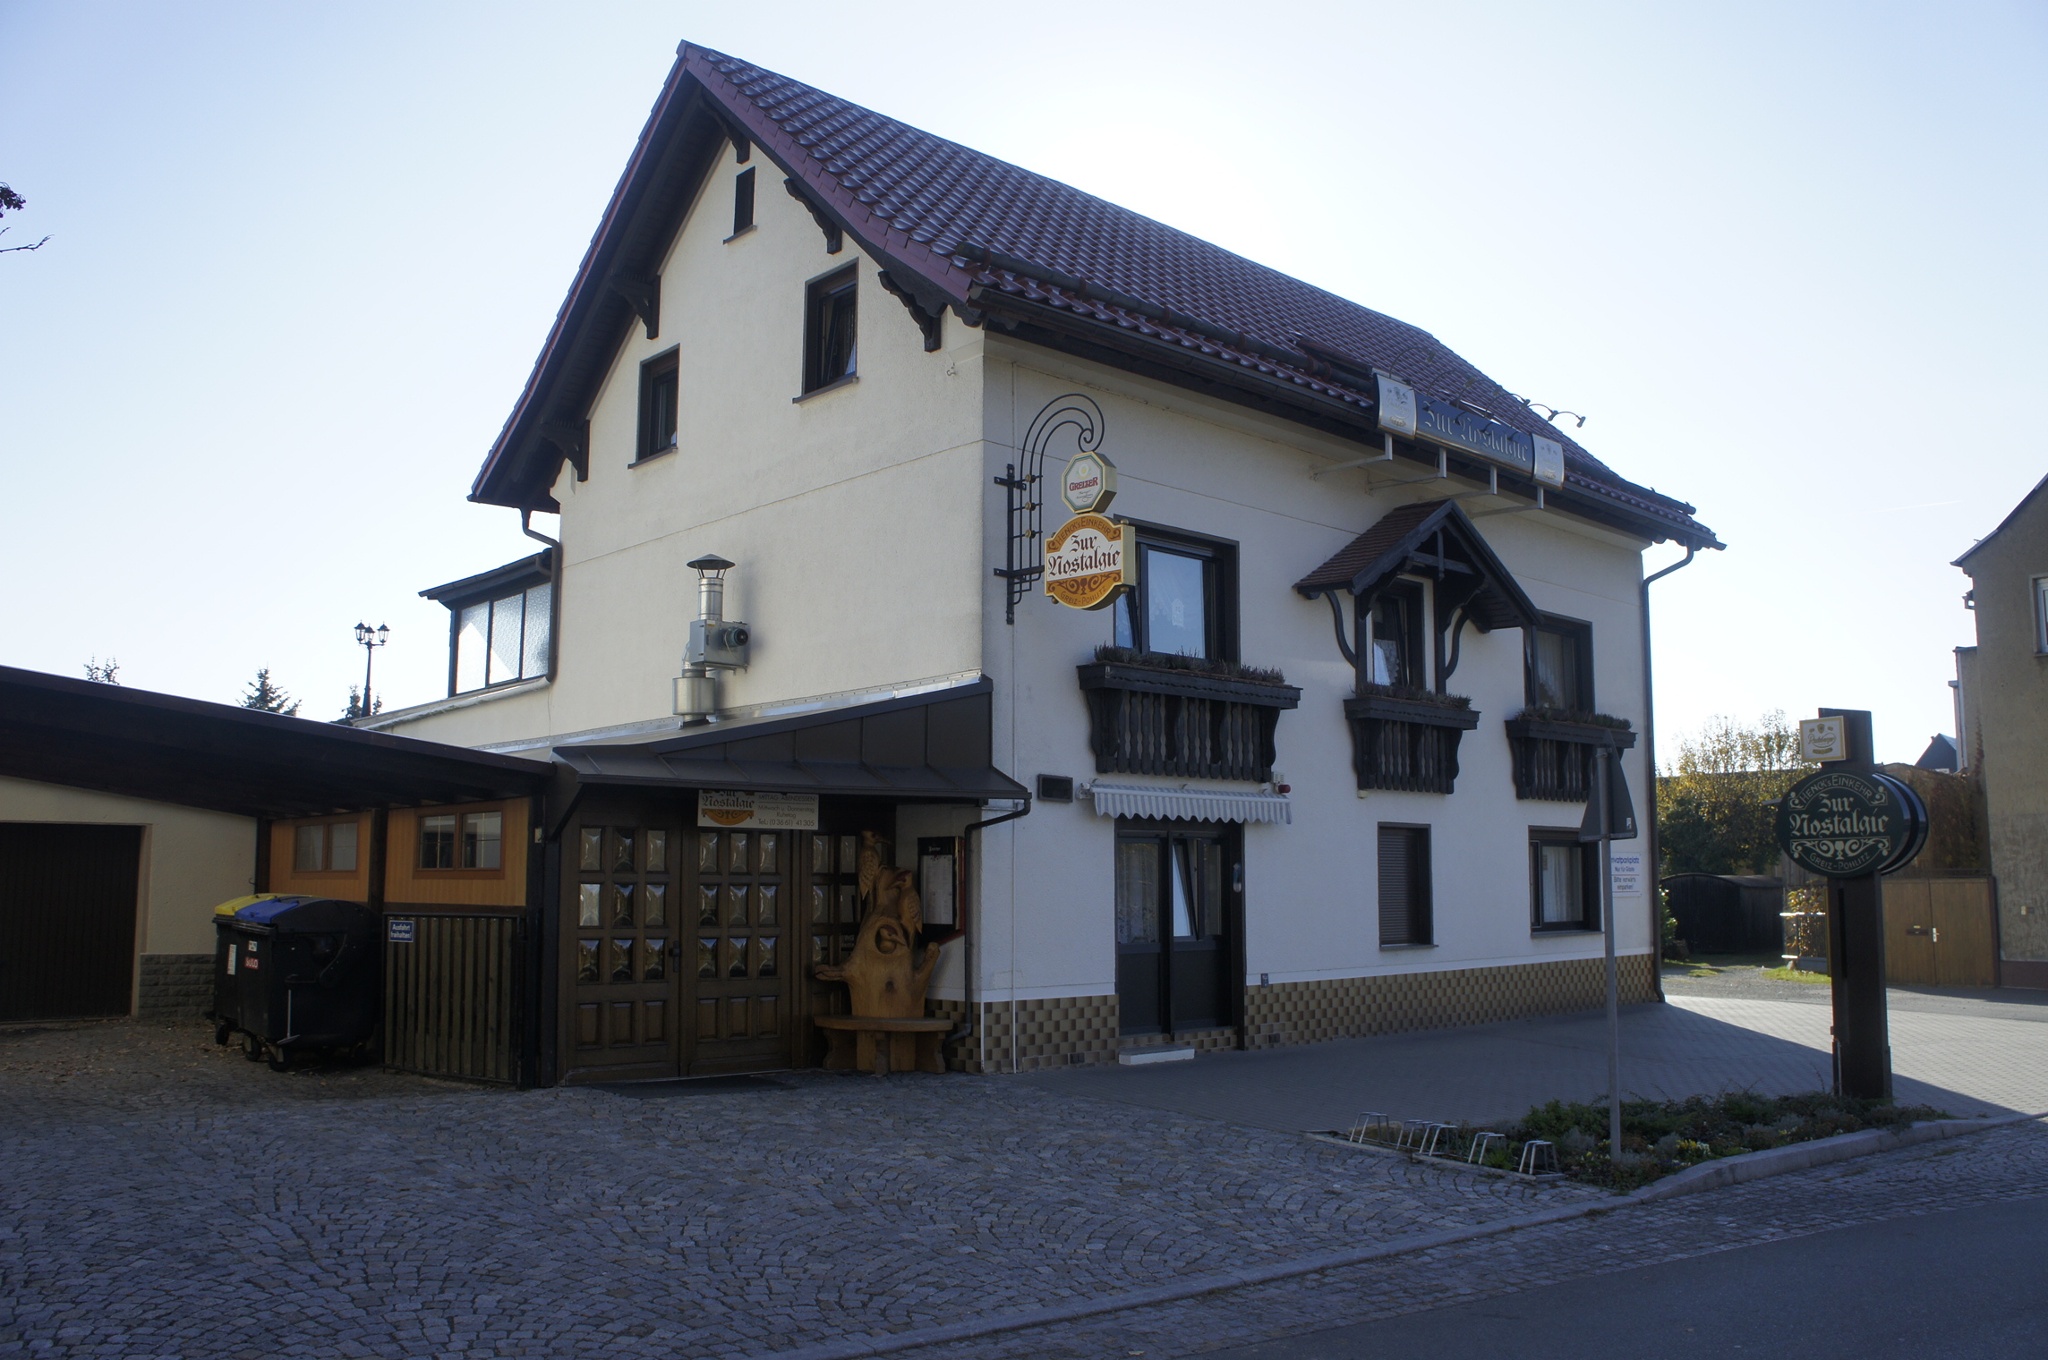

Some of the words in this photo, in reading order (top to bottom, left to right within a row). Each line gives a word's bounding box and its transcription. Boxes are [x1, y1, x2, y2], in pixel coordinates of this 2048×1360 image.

[1069, 477, 1098, 491] GREIZER
[1081, 517, 1111, 535] EINKEHR
[1070, 535, 1097, 553] Zur
[1048, 544, 1121, 577] Nostalgie
[1832, 775, 1873, 799] EINKEHR
[702, 795, 755, 810] Nostalgie
[1818, 793, 1855, 813] Zur
[1789, 807, 1889, 838] Nostalgie
[1611, 856, 1640, 864] rivatparkplatz
[390, 931, 412, 939] freihalten!
[392, 923, 411, 931] Ausfahrt
[245, 956, 259, 969] SULO
